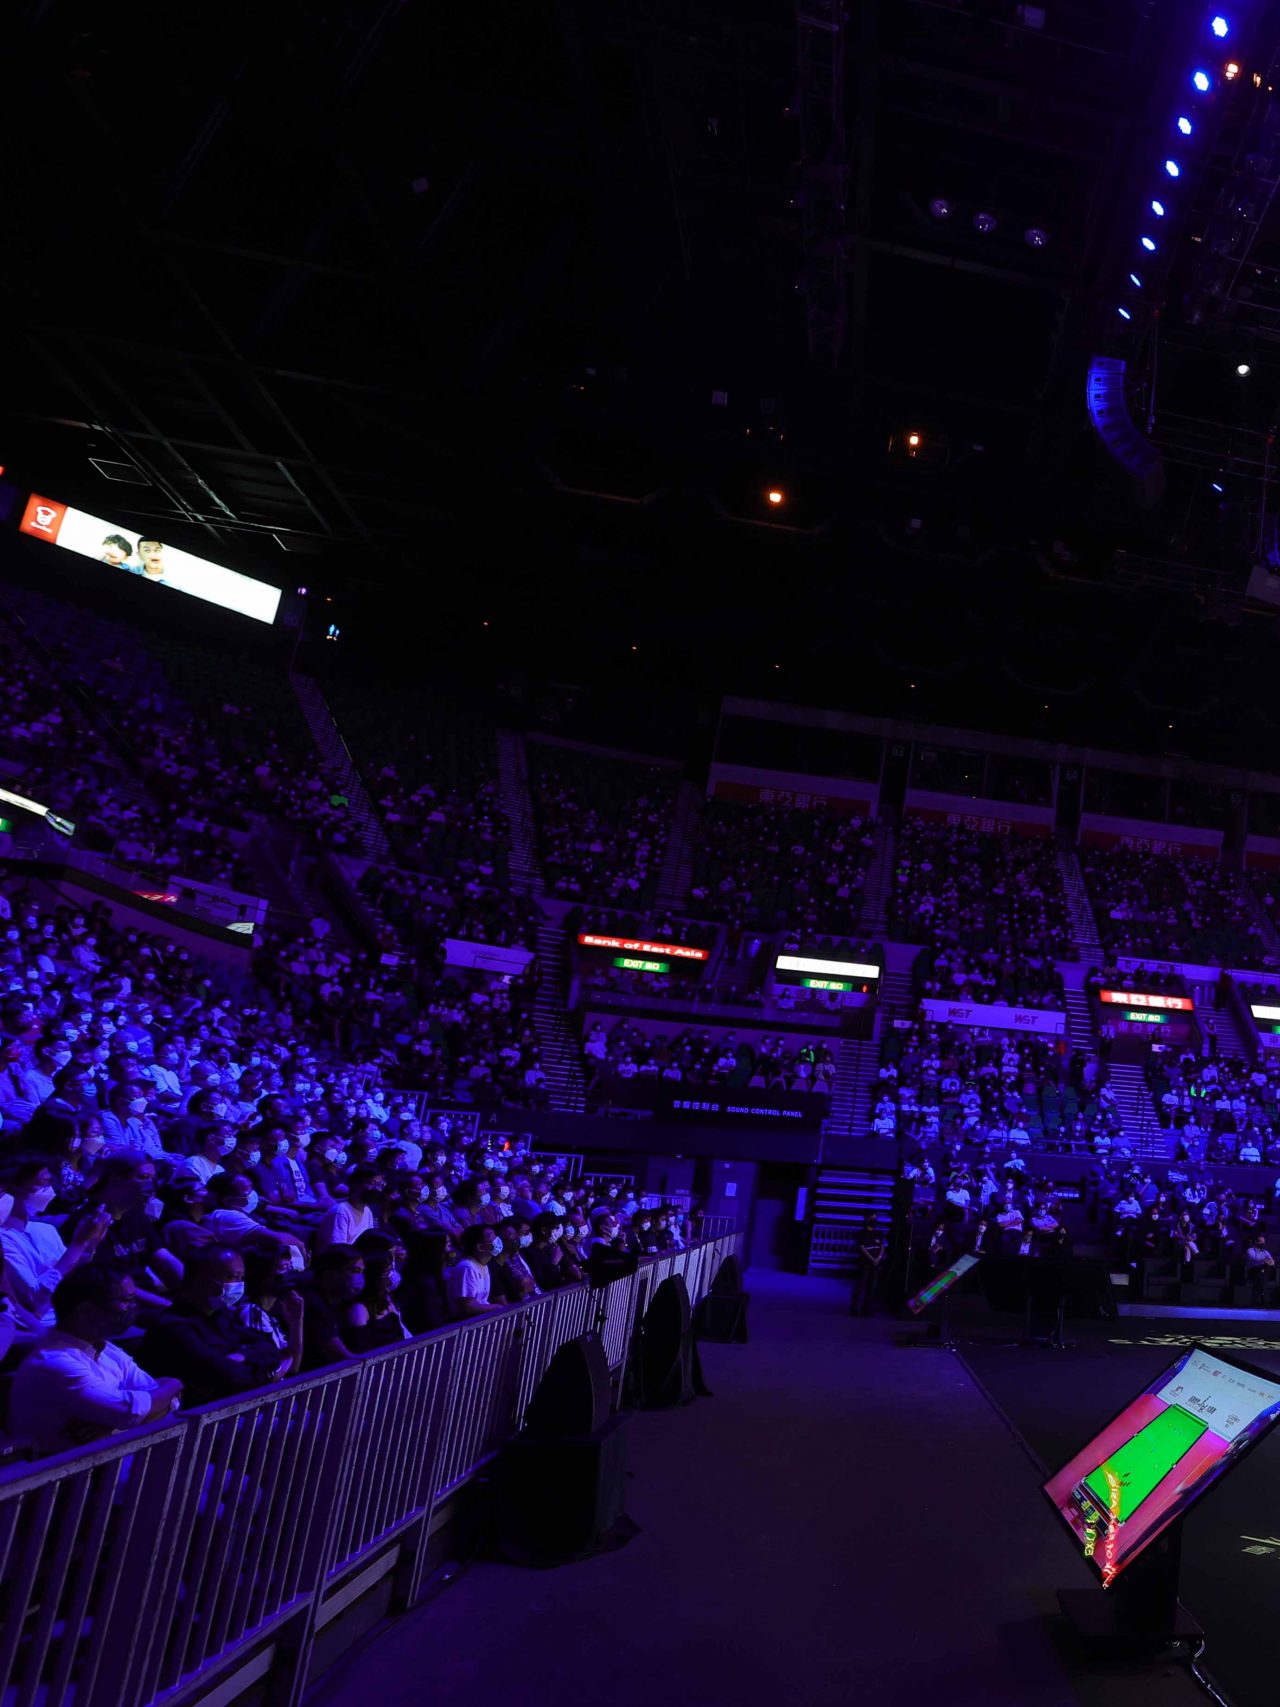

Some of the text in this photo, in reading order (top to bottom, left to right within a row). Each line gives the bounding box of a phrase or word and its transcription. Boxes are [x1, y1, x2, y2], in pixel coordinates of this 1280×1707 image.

[584, 936, 703, 958] Bank of East Asia
[623, 958, 644, 969] EXIT
[809, 979, 829, 989] EXIT
[1111, 992, 1184, 1009] 東亞銀行
[947, 1007, 1039, 1025] WST WST
[1129, 1012, 1147, 1021] EXIT
[727, 1105, 749, 1113] SOUND
[750, 1107, 780, 1116] CONTROL
[782, 1110, 803, 1118] PANEL
